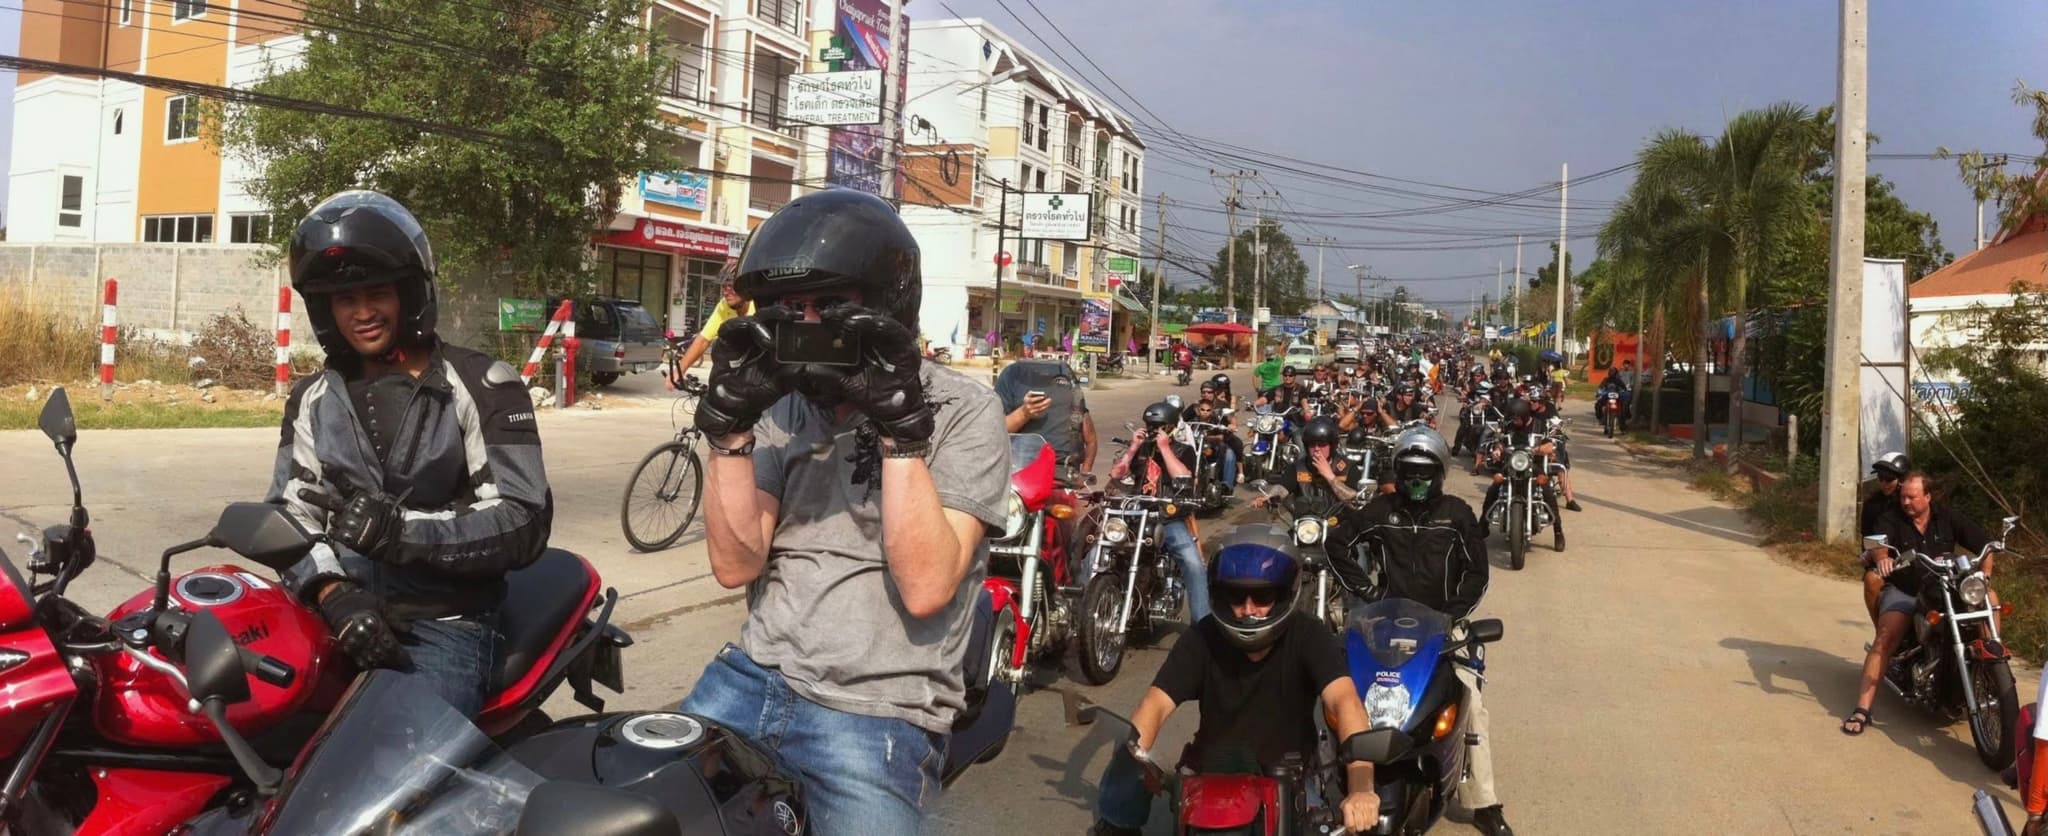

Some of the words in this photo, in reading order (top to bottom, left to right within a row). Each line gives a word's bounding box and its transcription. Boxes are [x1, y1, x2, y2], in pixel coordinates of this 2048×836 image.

[827, 112, 877, 122] TREATMENT
[1025, 208, 1086, 222] ตรวจโรคทั่วไป
